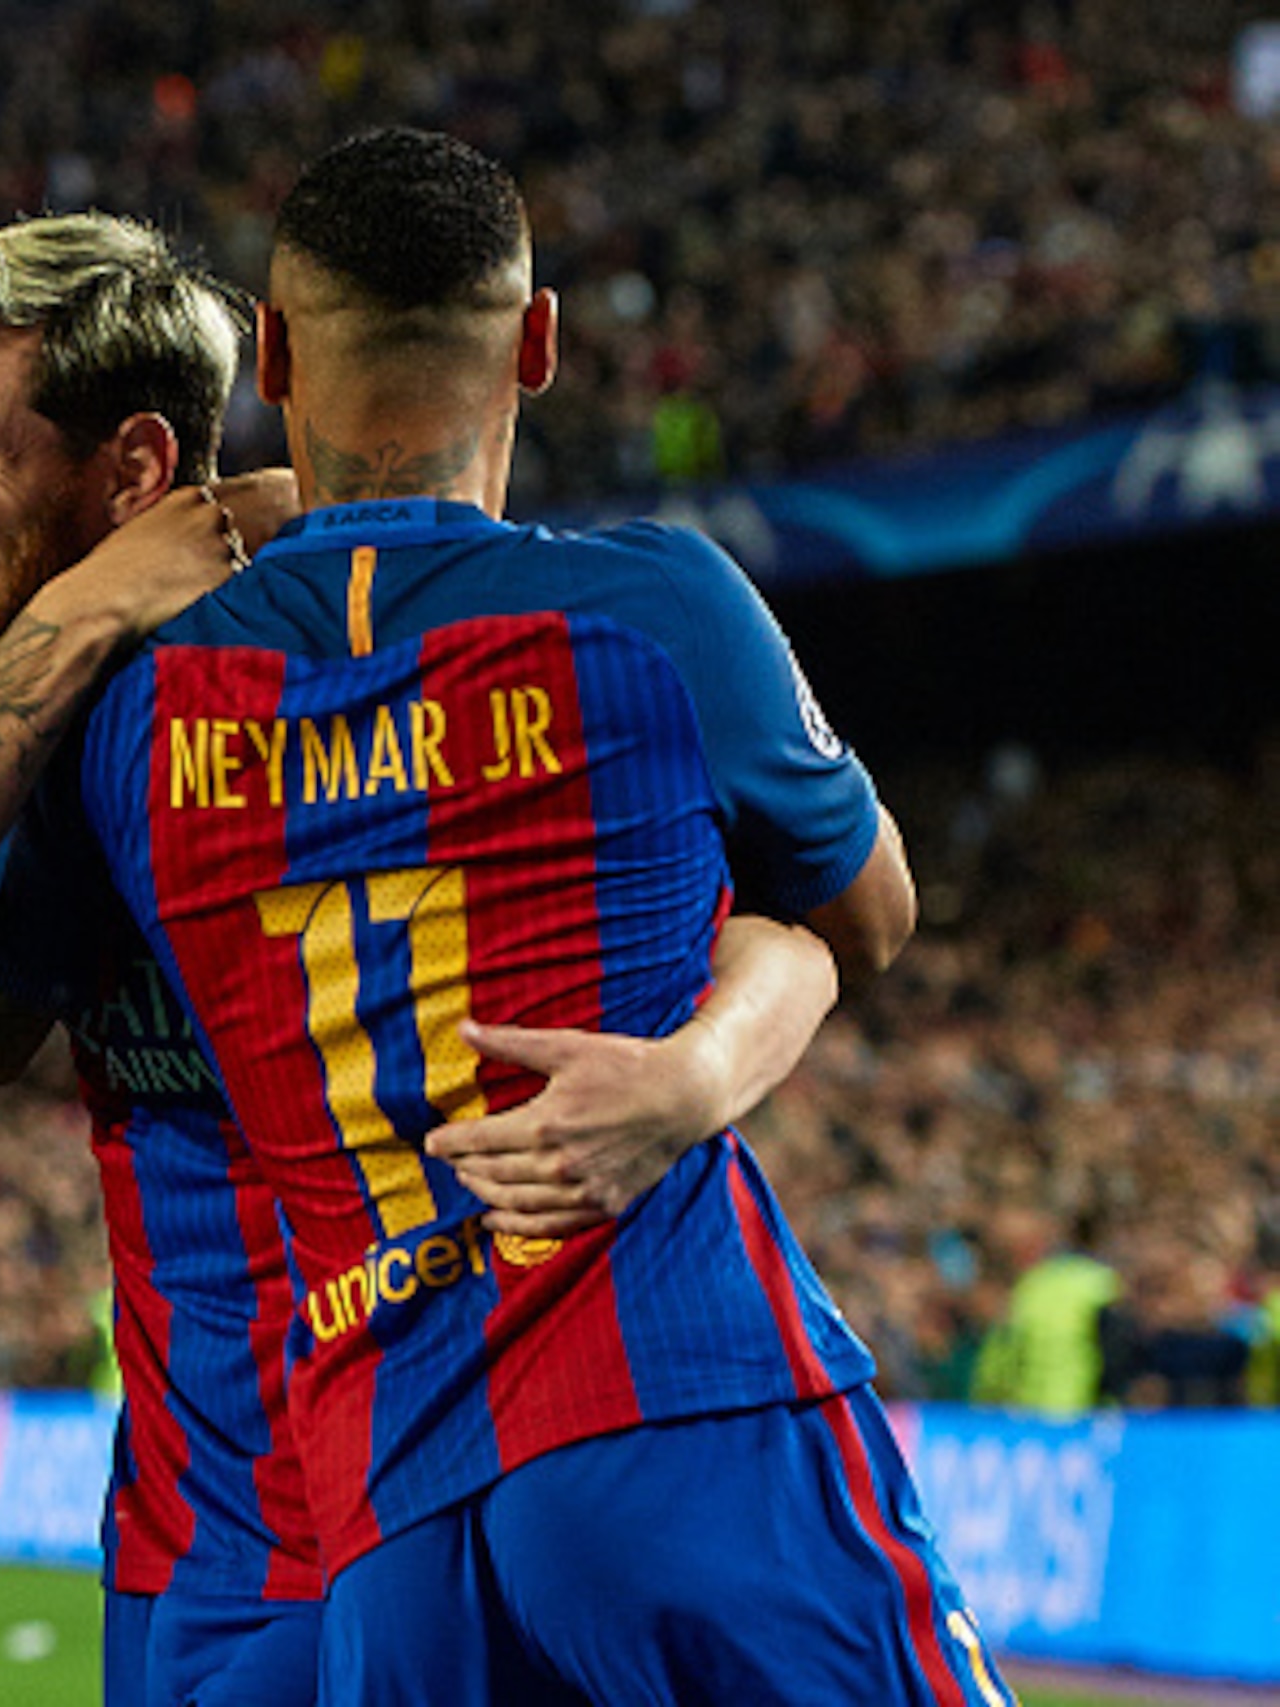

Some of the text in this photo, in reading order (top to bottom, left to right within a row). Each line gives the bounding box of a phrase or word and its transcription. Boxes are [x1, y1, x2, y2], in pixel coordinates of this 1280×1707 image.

[170, 686, 562, 808] NEYMAR JR
[254, 865, 488, 1240] 11
[308, 1212, 486, 1342] unicef
